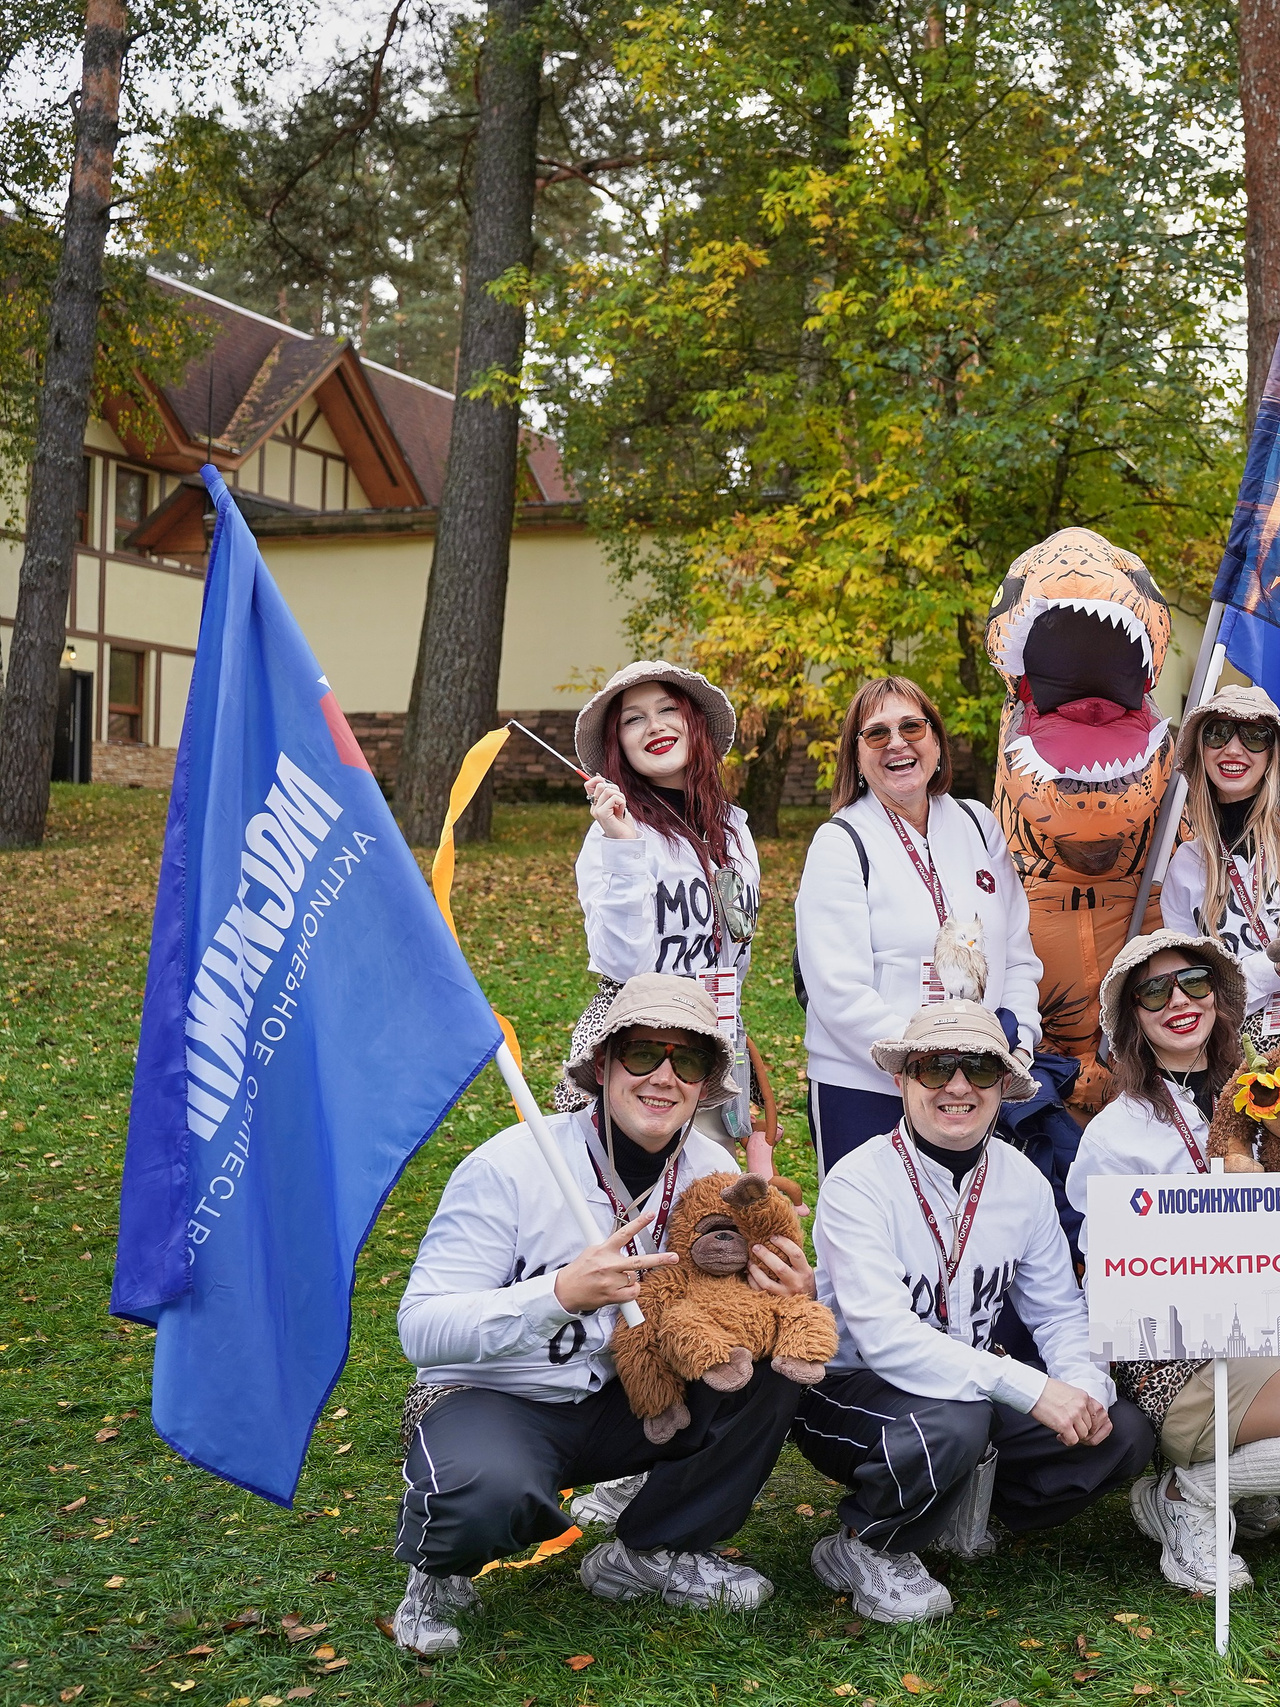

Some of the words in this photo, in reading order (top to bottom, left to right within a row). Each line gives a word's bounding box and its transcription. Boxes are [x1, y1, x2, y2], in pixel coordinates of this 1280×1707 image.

[914, 860, 931, 883] ГОРОДА
[1235, 883, 1248, 903] ГОРОДА
[1178, 1122, 1196, 1149] ГОРОДА
[896, 1143, 916, 1180] ФУНДАМЕНТ
[957, 1214, 972, 1242] ГОРОДА
